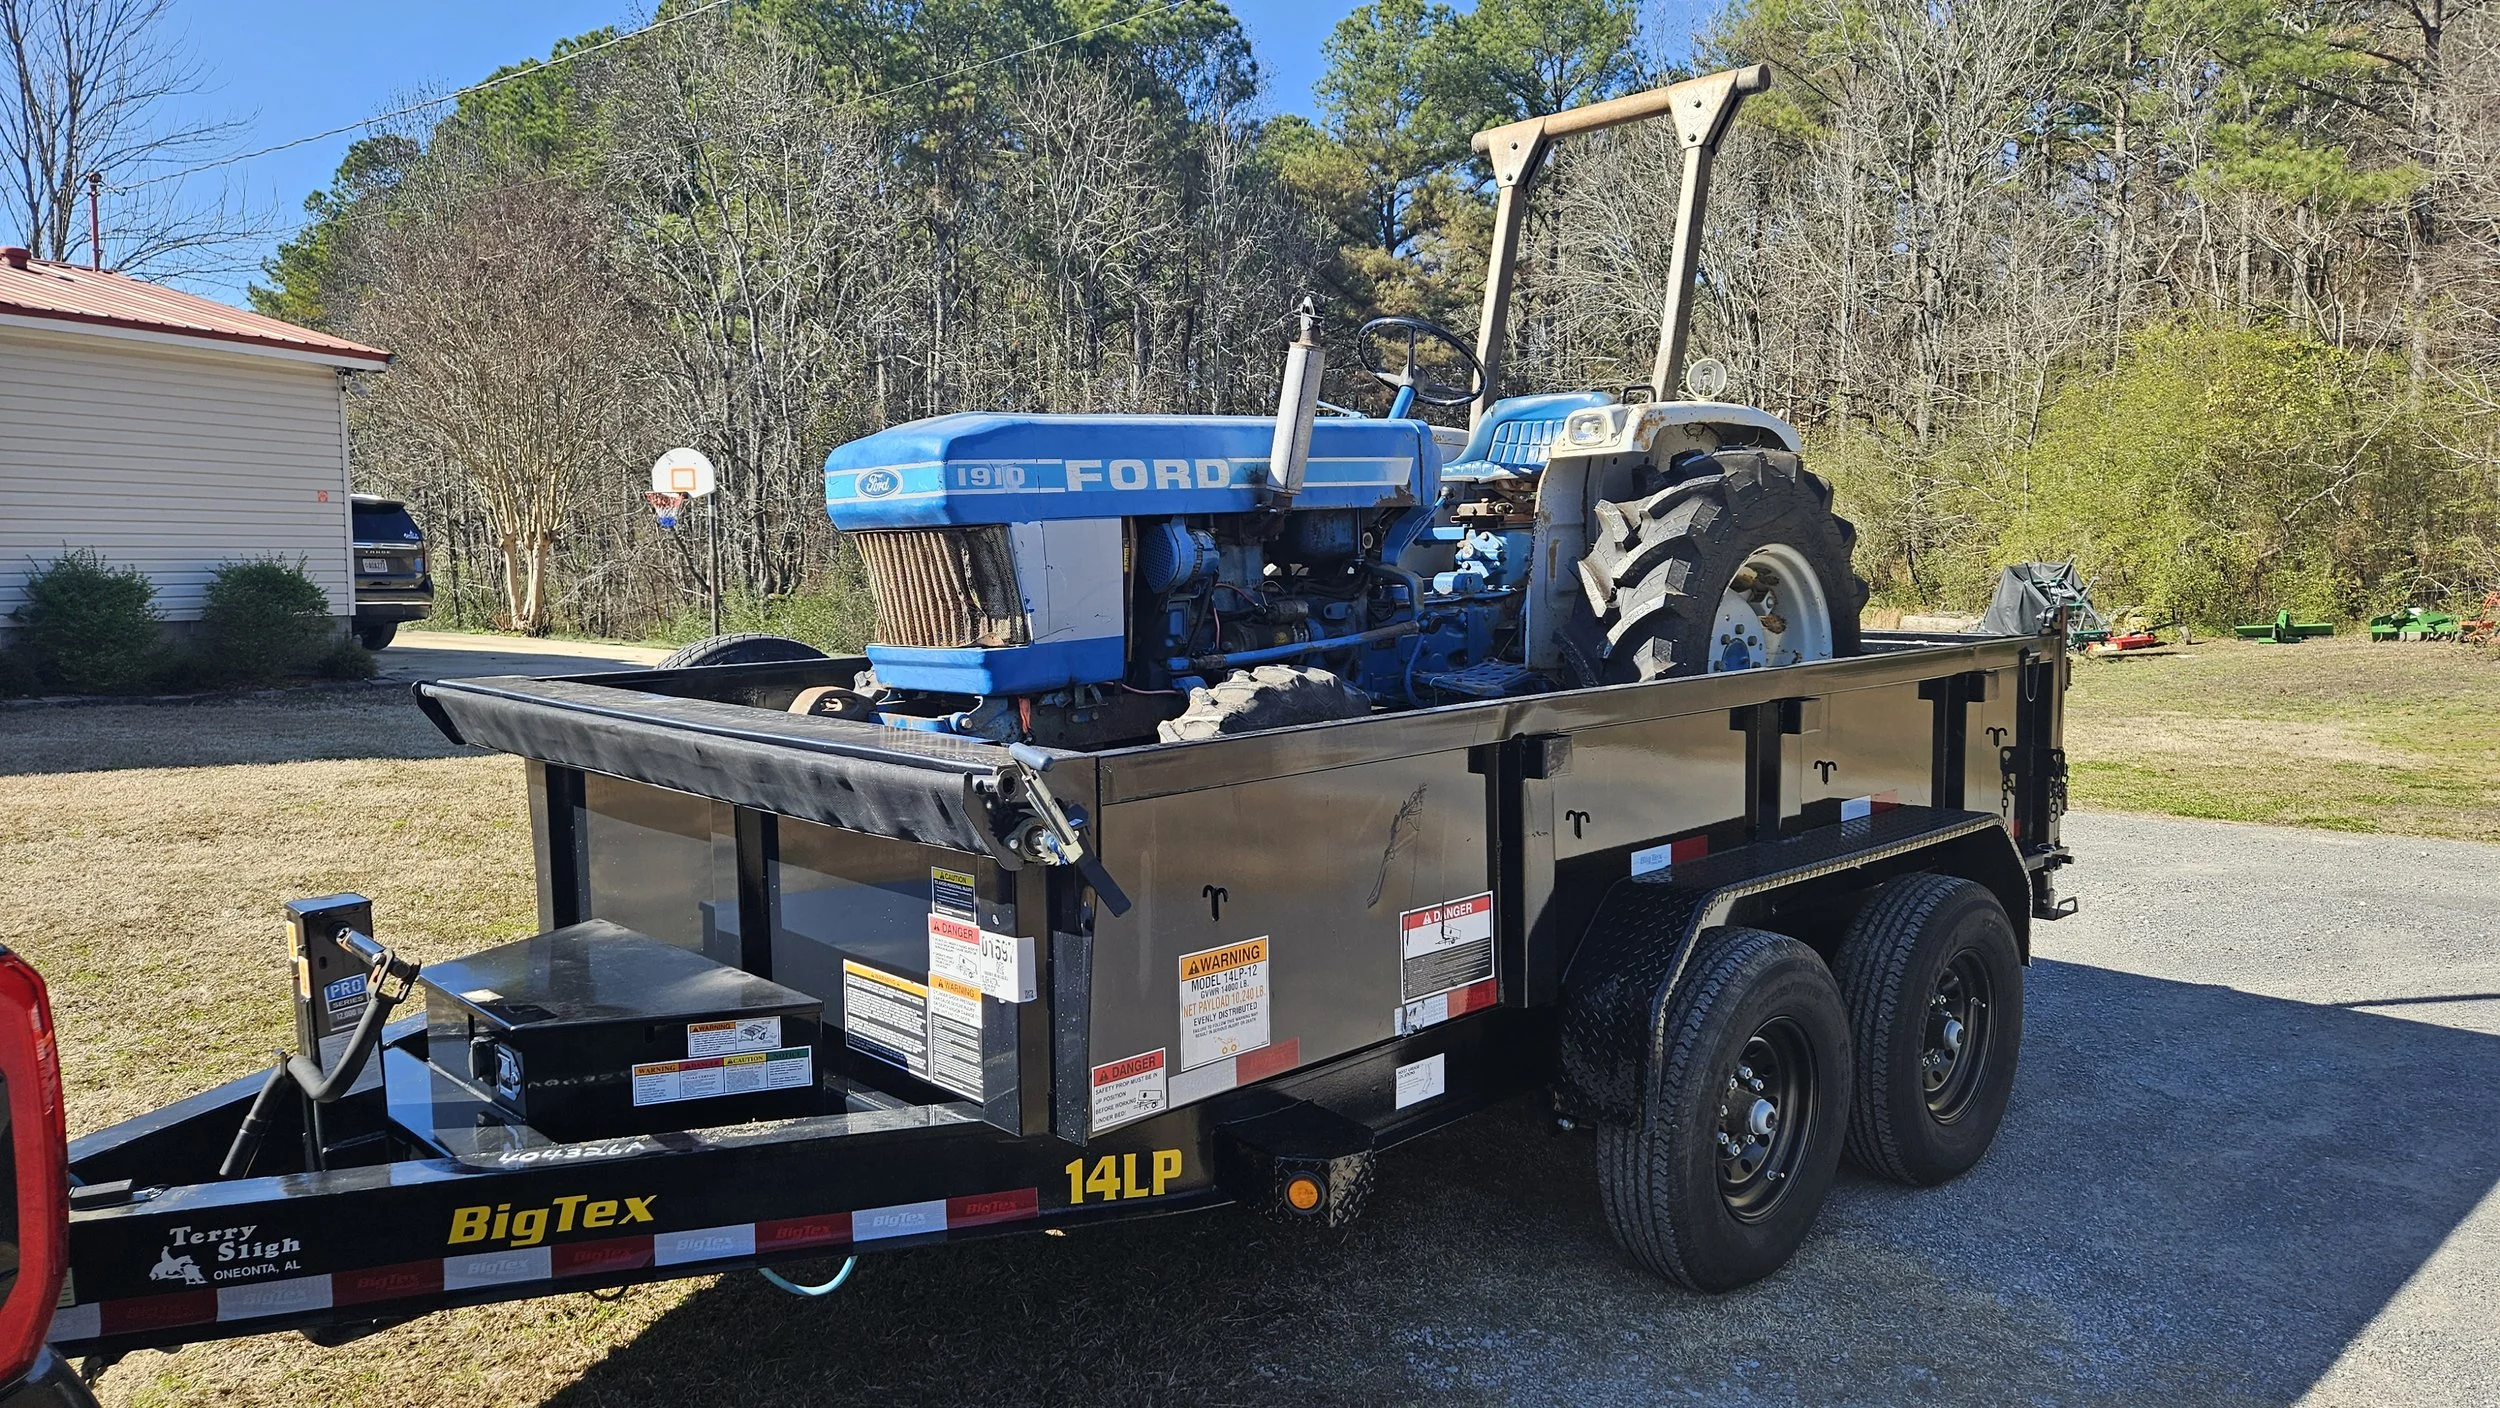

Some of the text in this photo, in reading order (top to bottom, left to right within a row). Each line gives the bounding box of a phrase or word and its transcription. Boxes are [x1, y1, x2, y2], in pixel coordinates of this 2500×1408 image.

[866, 472, 890, 493] Ford
[957, 465, 1025, 490] 1910
[1064, 459, 1229, 491] FORD
[944, 873, 967, 884] CAUTION
[1433, 902, 1473, 922] DANGER
[942, 922, 974, 941] DANGER
[1200, 945, 1260, 972] WARNING
[1191, 964, 1258, 992] MODEL 14LP-12
[330, 979, 362, 999] PRO
[944, 978, 975, 999] WARNING
[1200, 990, 1220, 999] GVWR
[332, 996, 364, 1009] SERIES
[1183, 1002, 1197, 1018] NET
[1198, 995, 1230, 1013] PAYLOAD
[1193, 1001, 1258, 1027] EVENLY DISTRIBUTED
[638, 1064, 676, 1075] WARNING
[732, 1055, 764, 1065] CAUTION
[1112, 1056, 1156, 1078] DANGER
[1095, 1084, 1115, 1096] SAFETY
[1095, 1114, 1114, 1125] UNDER
[1065, 1149, 1183, 1205] 14LP
[965, 1199, 1018, 1214] BigTex
[447, 1194, 657, 1248] BigTex
[872, 1212, 926, 1227] BigTex
[169, 1225, 258, 1246] Terry
[775, 1224, 832, 1240] BigTex
[218, 1238, 301, 1262] Sligh
[676, 1236, 734, 1252] BigTex
[213, 1260, 301, 1281] ONEONTA, AL
[467, 1259, 528, 1276] BigTex
